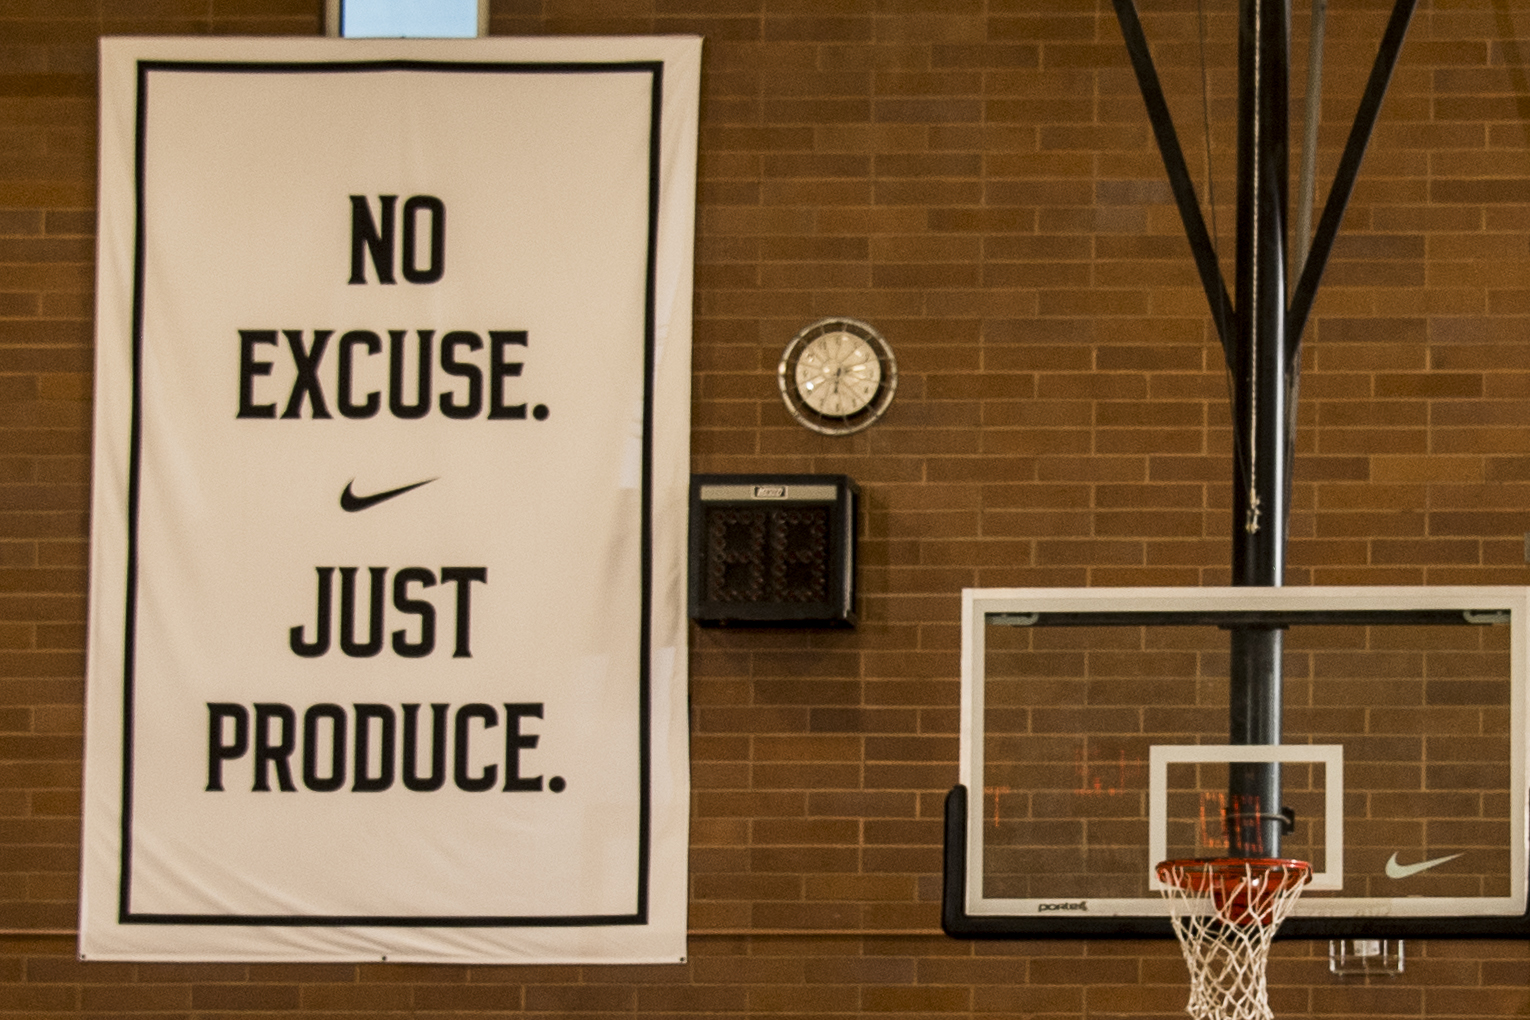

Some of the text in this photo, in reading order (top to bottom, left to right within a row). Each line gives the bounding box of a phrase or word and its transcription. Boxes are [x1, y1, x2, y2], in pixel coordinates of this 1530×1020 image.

[348, 195, 447, 285] NO
[236, 329, 551, 421] EXCUSE.
[289, 566, 488, 658] JUST
[204, 702, 567, 793] PRODUCE.
